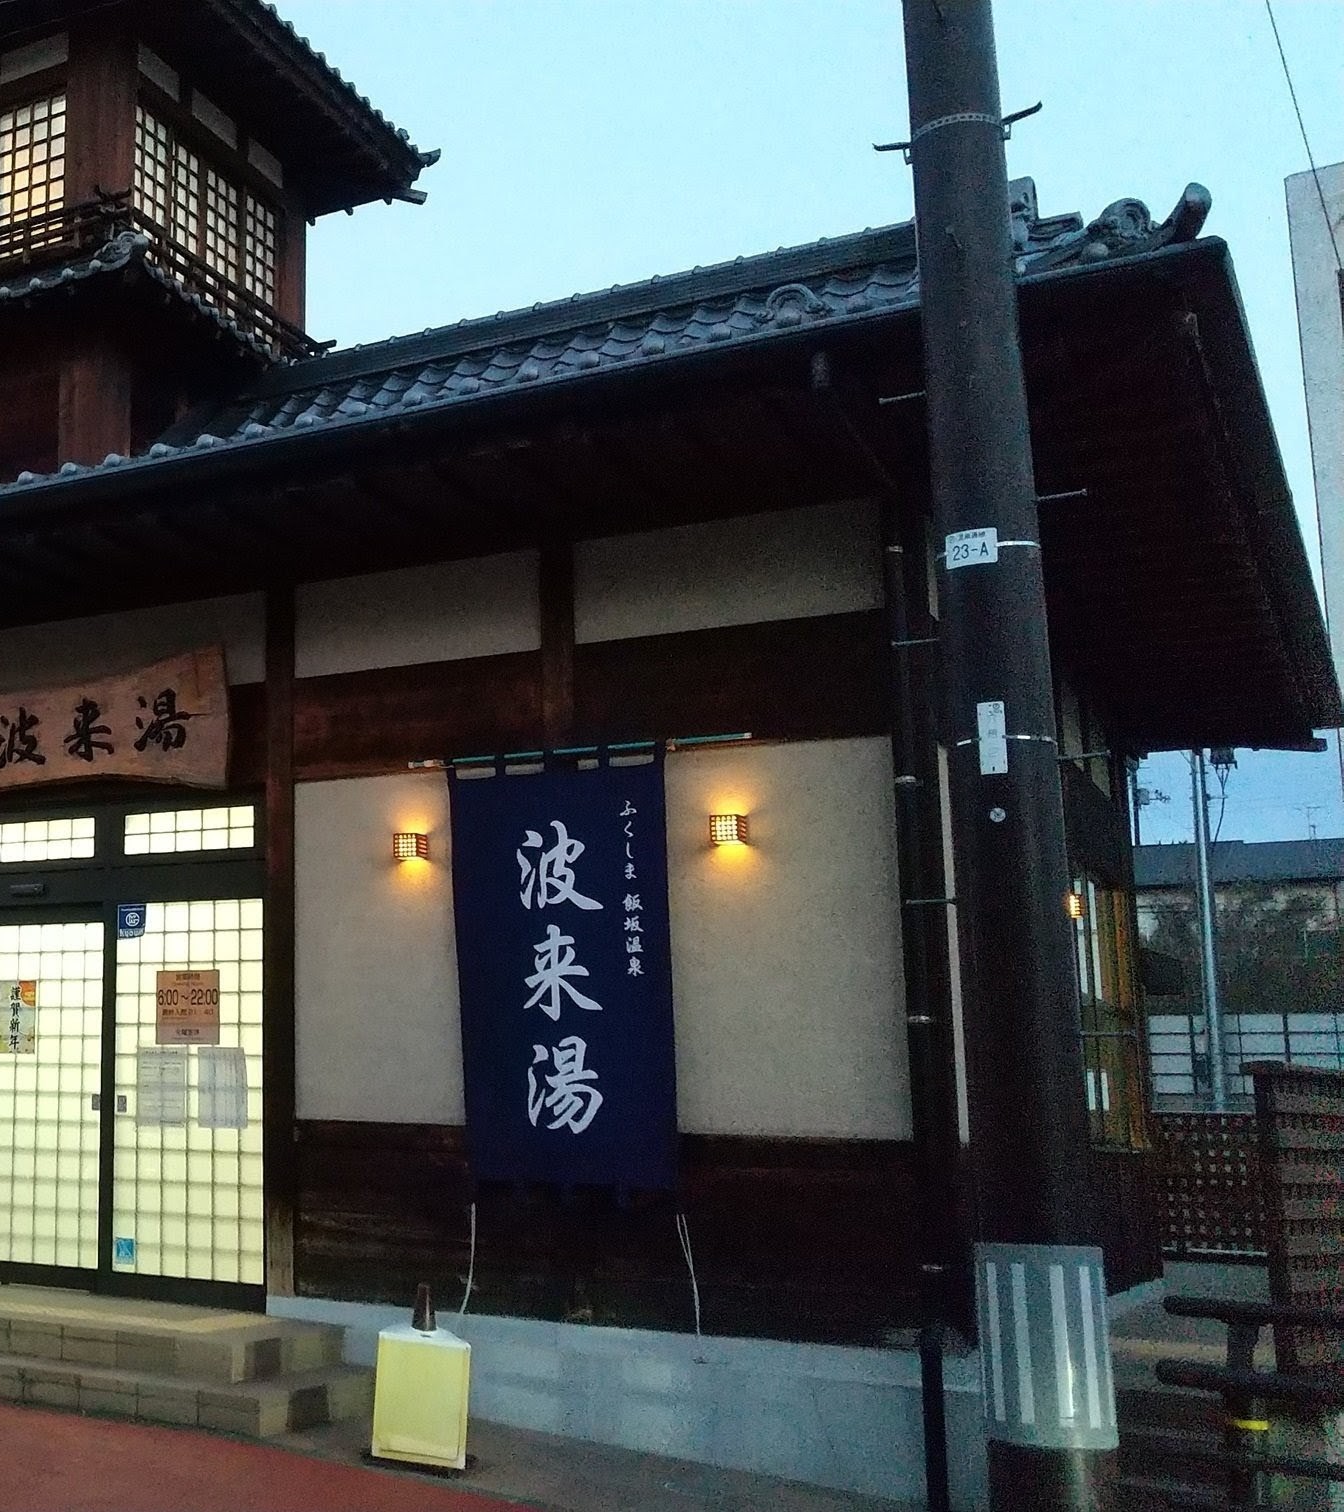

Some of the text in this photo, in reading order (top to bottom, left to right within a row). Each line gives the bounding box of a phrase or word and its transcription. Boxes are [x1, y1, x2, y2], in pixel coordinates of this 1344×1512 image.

[952, 541, 989, 561] 23-A
[619, 800, 645, 977] ふくしま 飯坂温泉
[516, 820, 604, 1135] 波来湯
